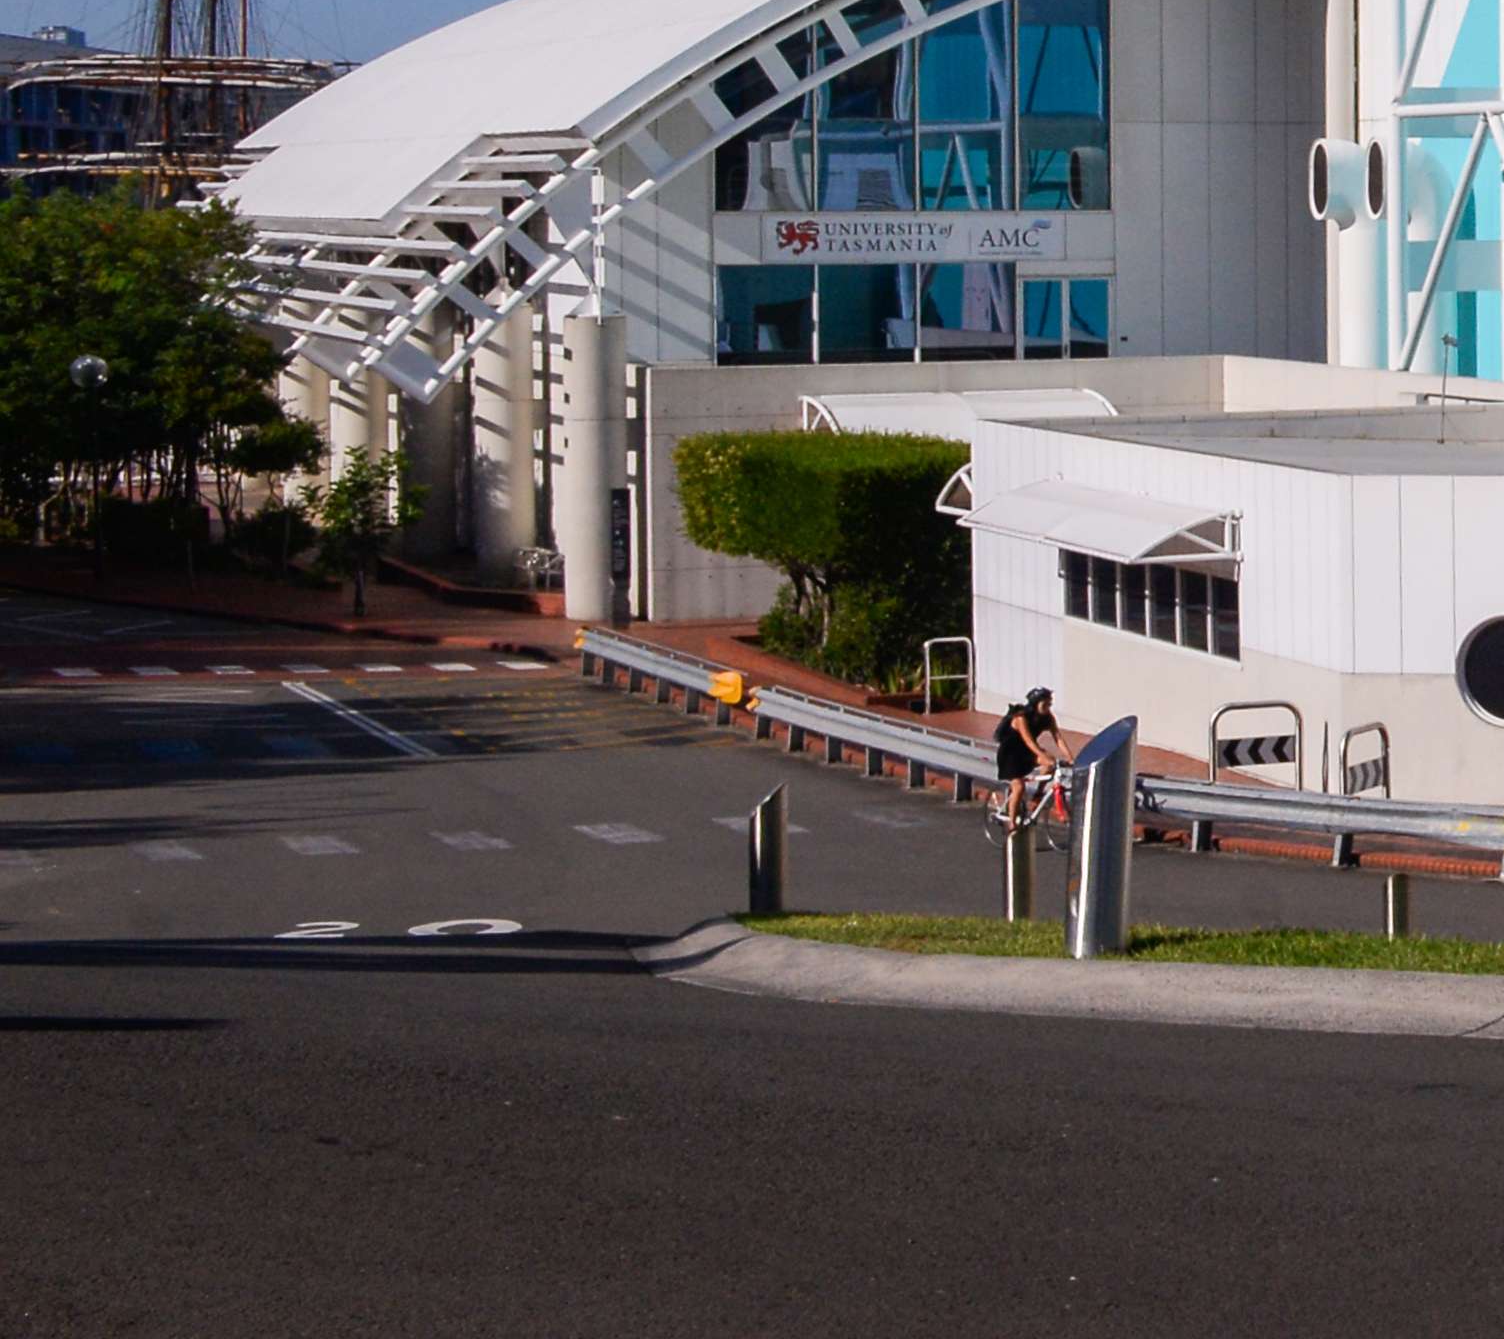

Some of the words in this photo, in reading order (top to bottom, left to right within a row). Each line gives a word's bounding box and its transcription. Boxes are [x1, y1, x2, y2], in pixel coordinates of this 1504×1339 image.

[824, 223, 936, 235] UNIVERSITY
[939, 223, 953, 239] of
[979, 228, 1039, 248] AMC
[825, 238, 937, 252] TASMANIA
